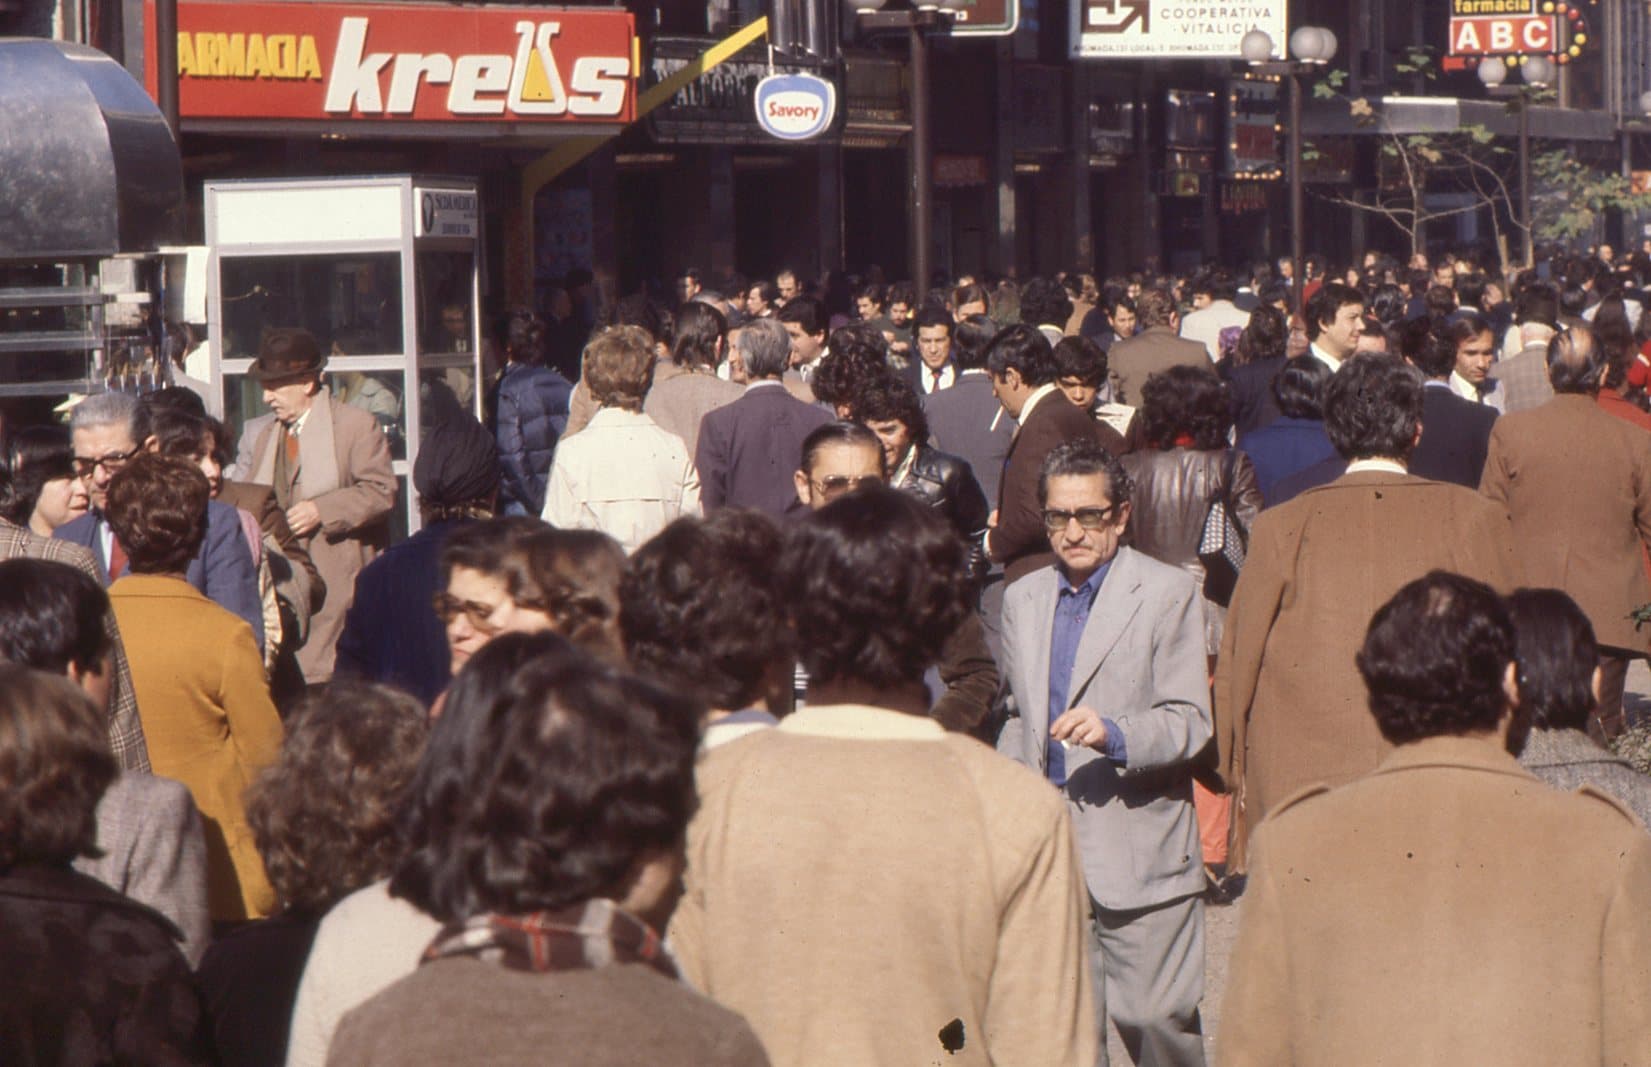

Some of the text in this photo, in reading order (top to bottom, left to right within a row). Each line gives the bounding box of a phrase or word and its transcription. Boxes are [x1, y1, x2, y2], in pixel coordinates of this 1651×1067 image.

[1455, 0, 1530, 13] farmacia
[1160, 8, 1271, 19] COOPERATIVA
[1181, 23, 1259, 35] VITALICIA
[769, 102, 819, 120] Savory
